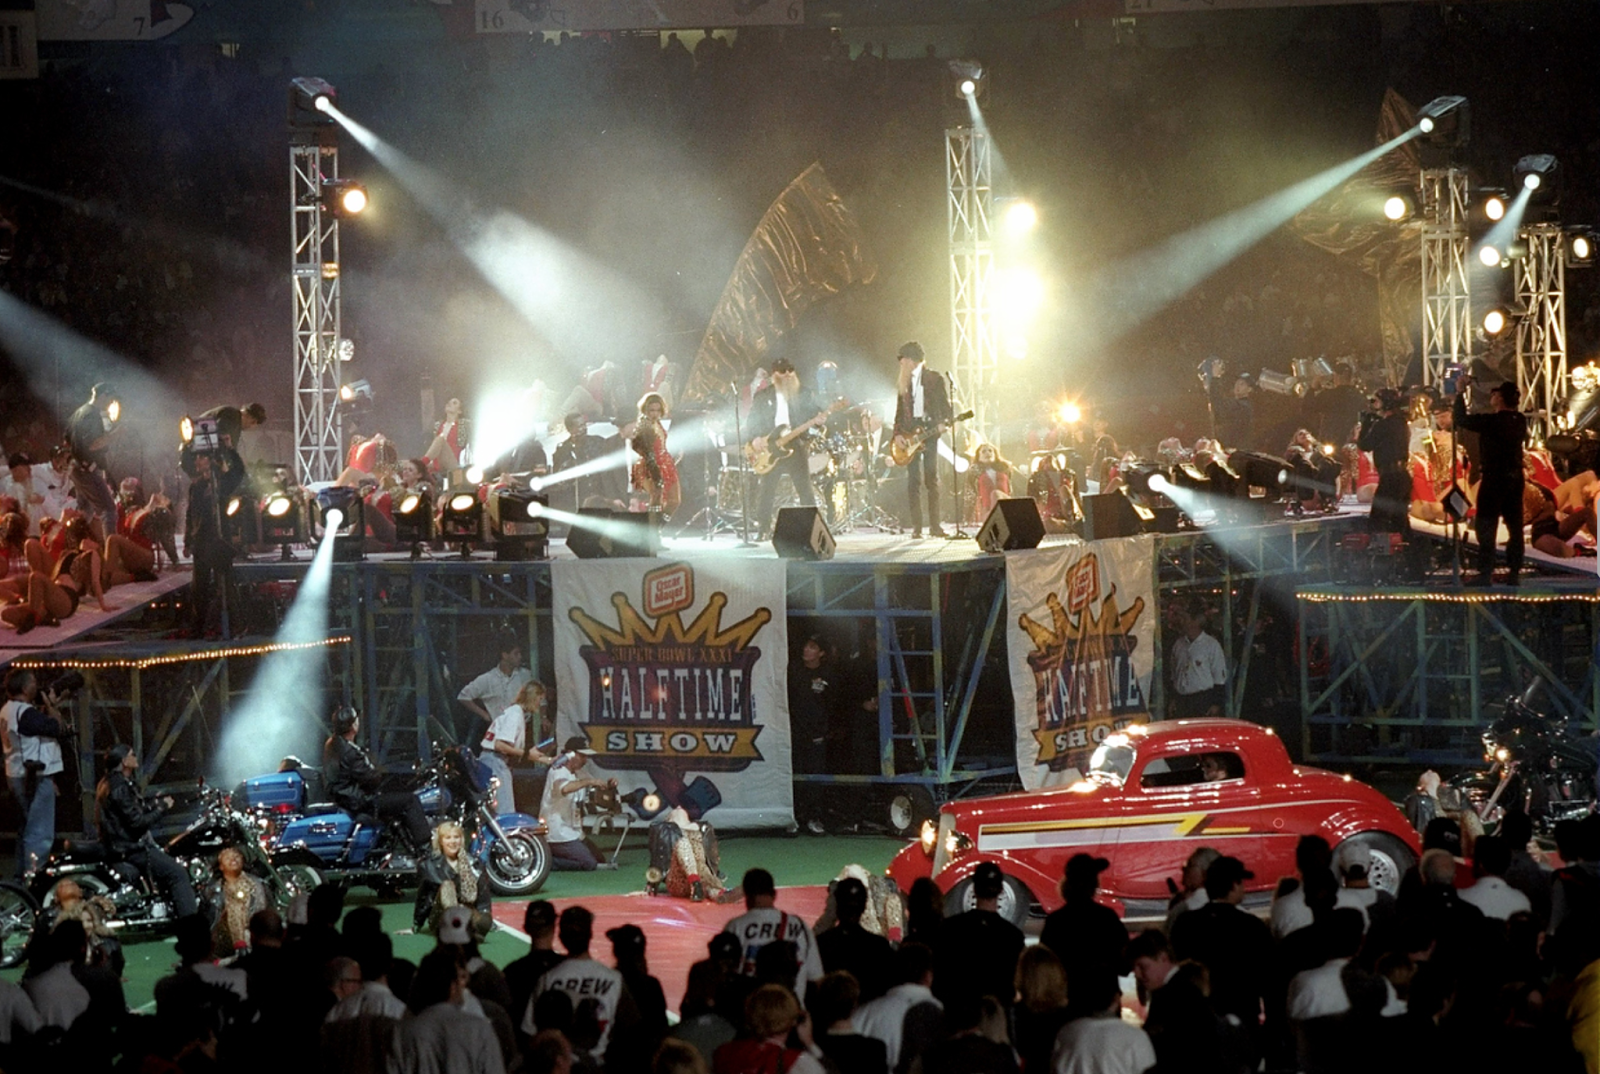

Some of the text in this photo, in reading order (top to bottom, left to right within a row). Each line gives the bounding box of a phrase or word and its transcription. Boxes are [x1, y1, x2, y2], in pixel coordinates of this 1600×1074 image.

[133, 16, 145, 36] 7
[482, 9, 504, 30] 16
[613, 647, 732, 662] SUPER BOWL XXXI
[600, 666, 743, 721] HALFTIME
[606, 731, 737, 751] SHOW
